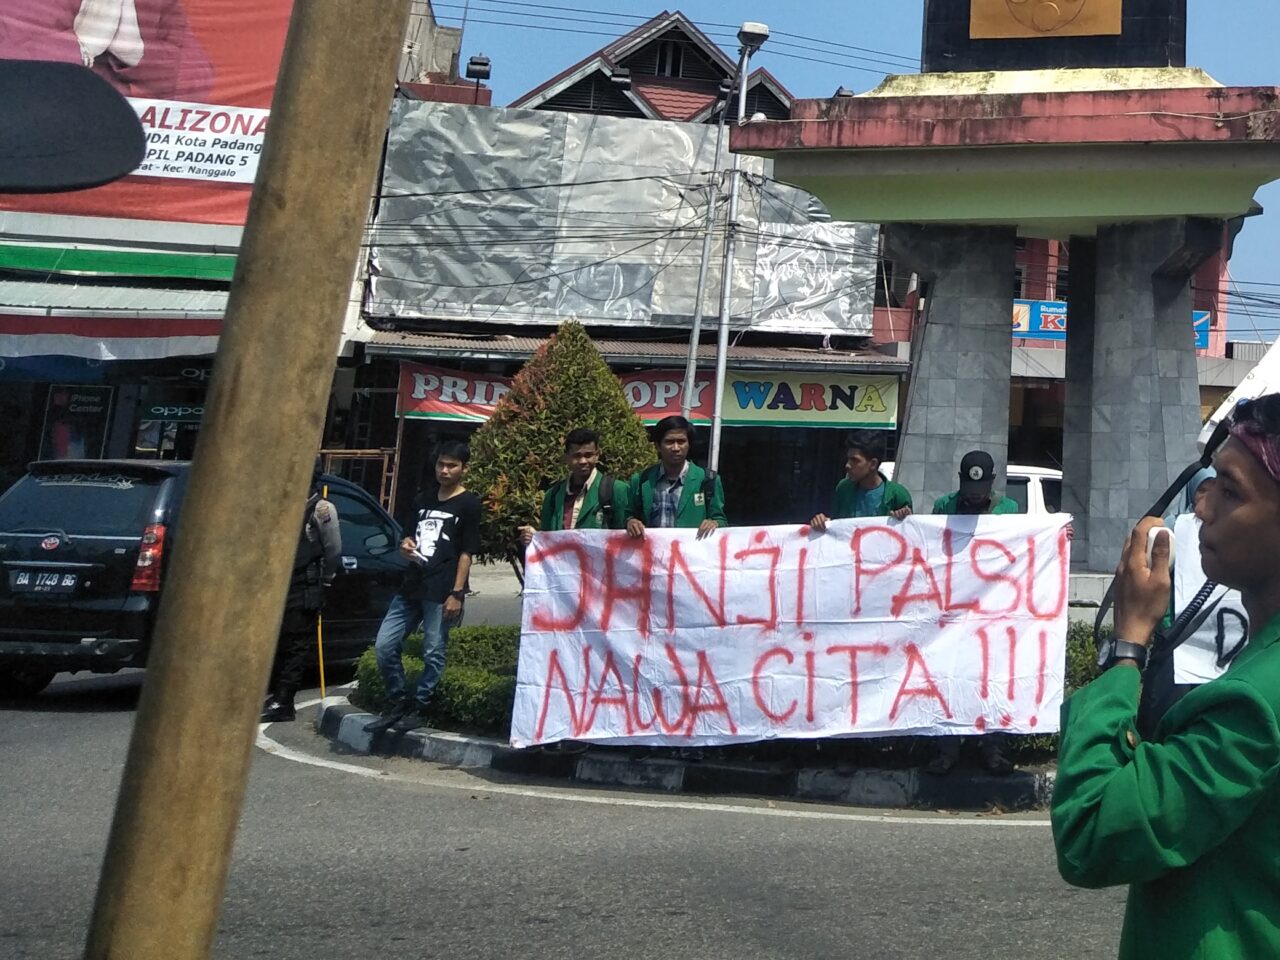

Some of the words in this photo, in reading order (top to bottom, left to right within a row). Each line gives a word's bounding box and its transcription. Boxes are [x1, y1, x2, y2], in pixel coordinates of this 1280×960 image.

[174, 135, 207, 147] Kota
[211, 137, 263, 154] Padang
[147, 149, 170, 161] PIL
[175, 151, 236, 166] PADANG
[238, 156, 249, 166] 5
[162, 164, 185, 173] Kec.
[188, 167, 236, 178] Nanggalo
[411, 372, 504, 406] PRI
[624, 380, 710, 409] OPY
[732, 381, 888, 413] WARNA
[16, 572, 29, 585] BA
[35, 573, 59, 586] 1748
[851, 522, 1068, 628] PALSU
